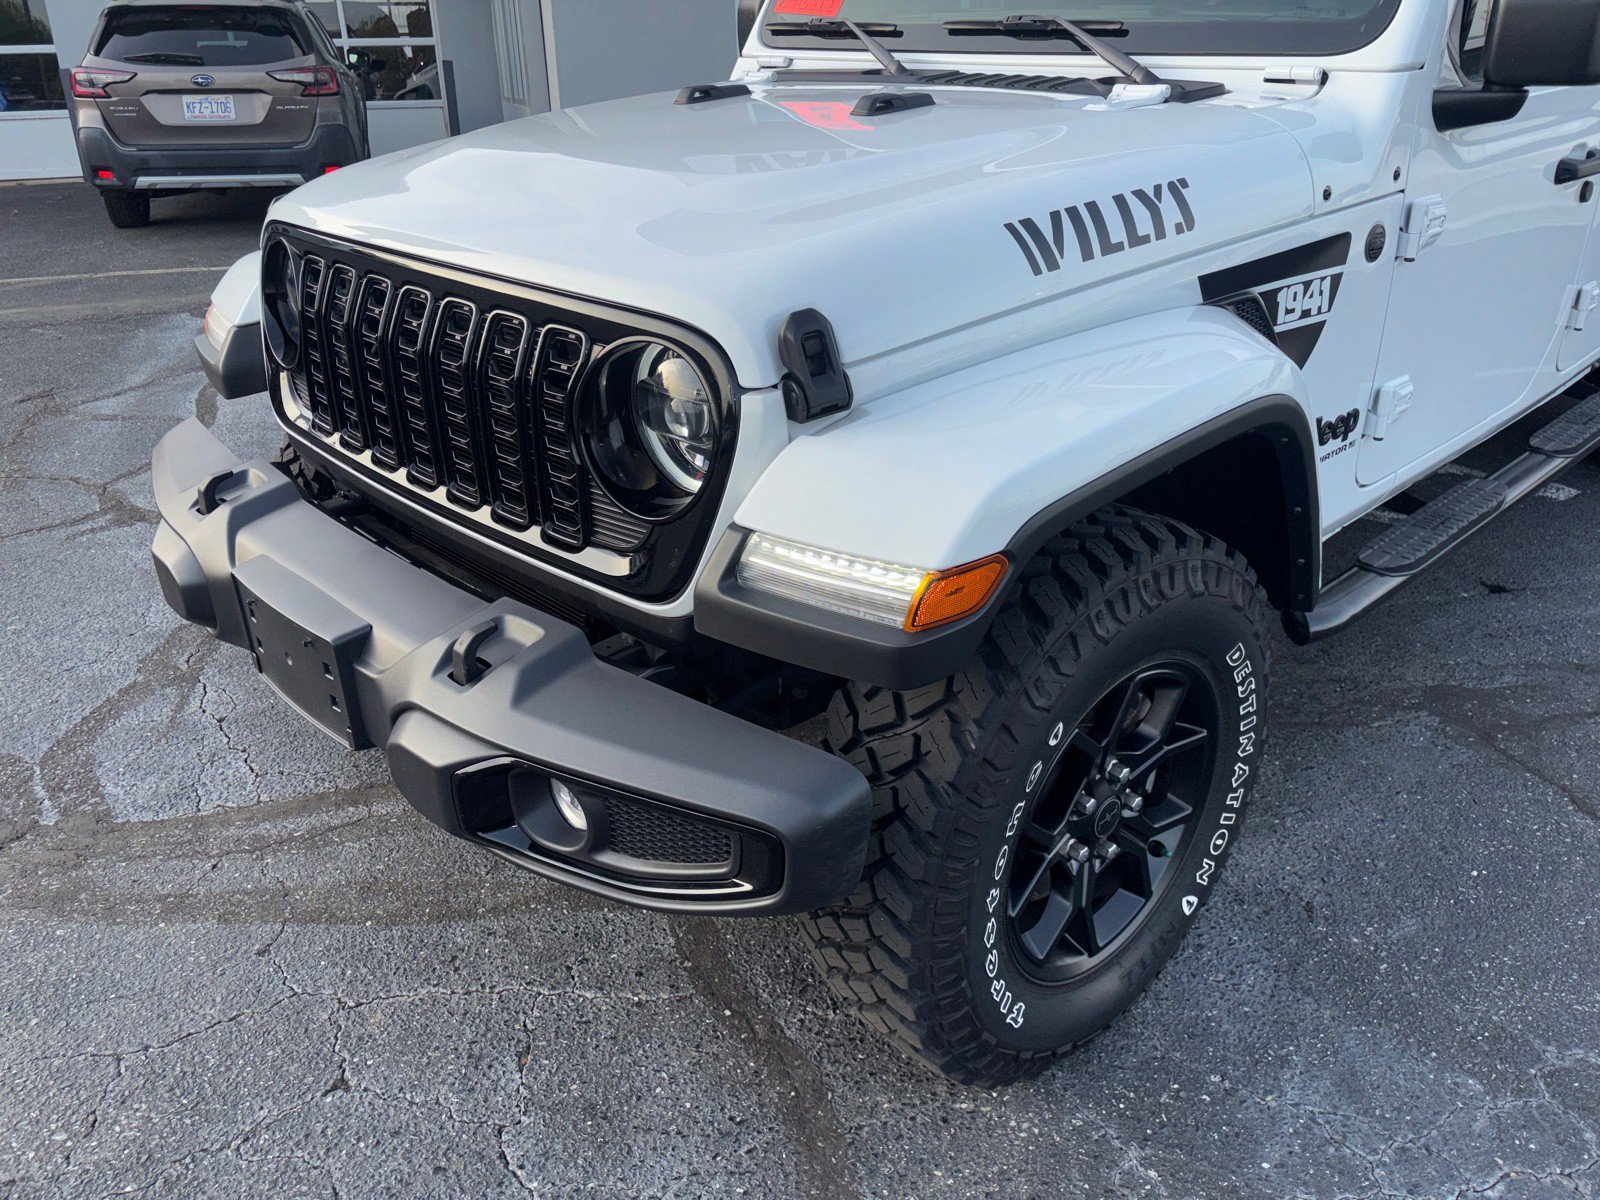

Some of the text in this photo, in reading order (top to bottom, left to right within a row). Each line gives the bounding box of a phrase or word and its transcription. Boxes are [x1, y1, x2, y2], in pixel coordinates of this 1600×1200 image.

[185, 101, 232, 114] KFZ-1706
[1003, 177, 1196, 276] WILLYS
[1276, 275, 1332, 325] 1941
[1196, 642, 1257, 886] DESTINATION
[983, 760, 1044, 1029] Firestone
